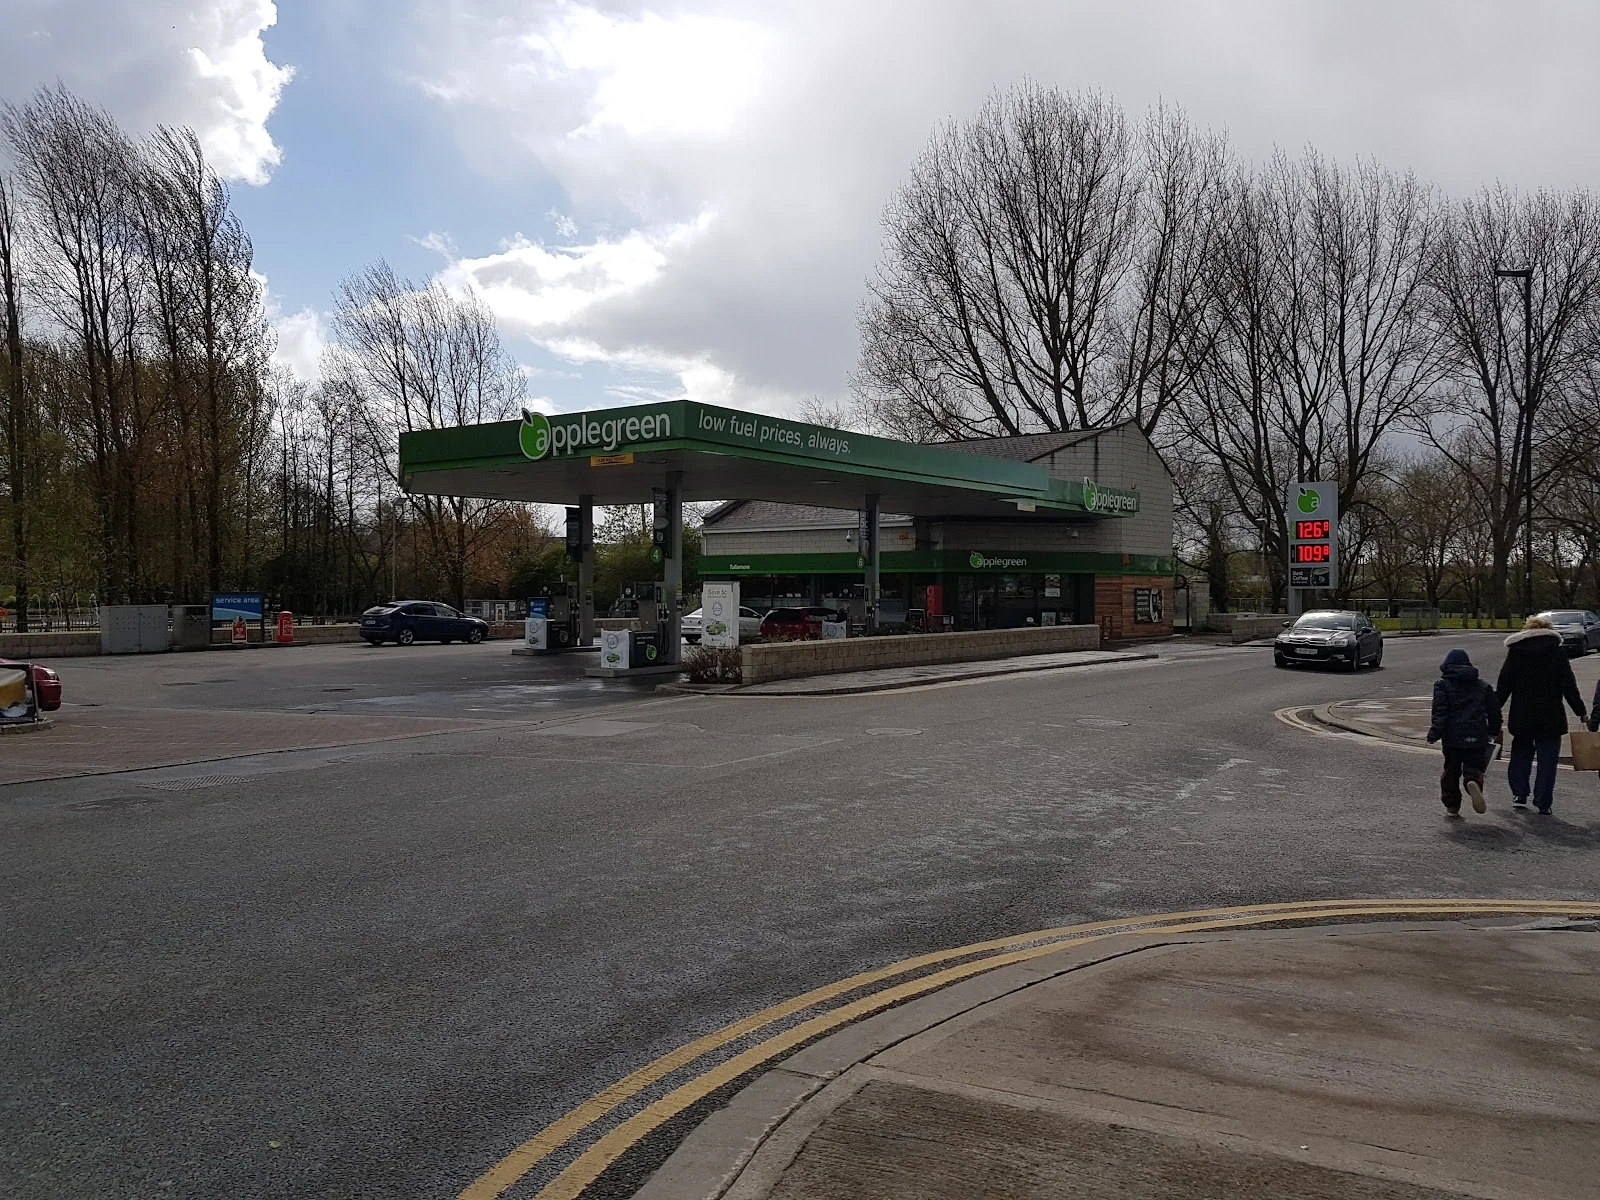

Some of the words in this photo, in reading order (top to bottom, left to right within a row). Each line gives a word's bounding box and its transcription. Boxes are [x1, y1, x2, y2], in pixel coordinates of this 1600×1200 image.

[535, 413, 671, 457] applegreen
[698, 409, 726, 432] low
[729, 415, 757, 438] fuel
[760, 423, 804, 448] prices,
[807, 431, 851, 455] always.
[1090, 488, 1137, 513] applegreen
[1310, 496, 1319, 508] a
[977, 555, 1027, 568] applegreen
[215, 596, 241, 604] service
